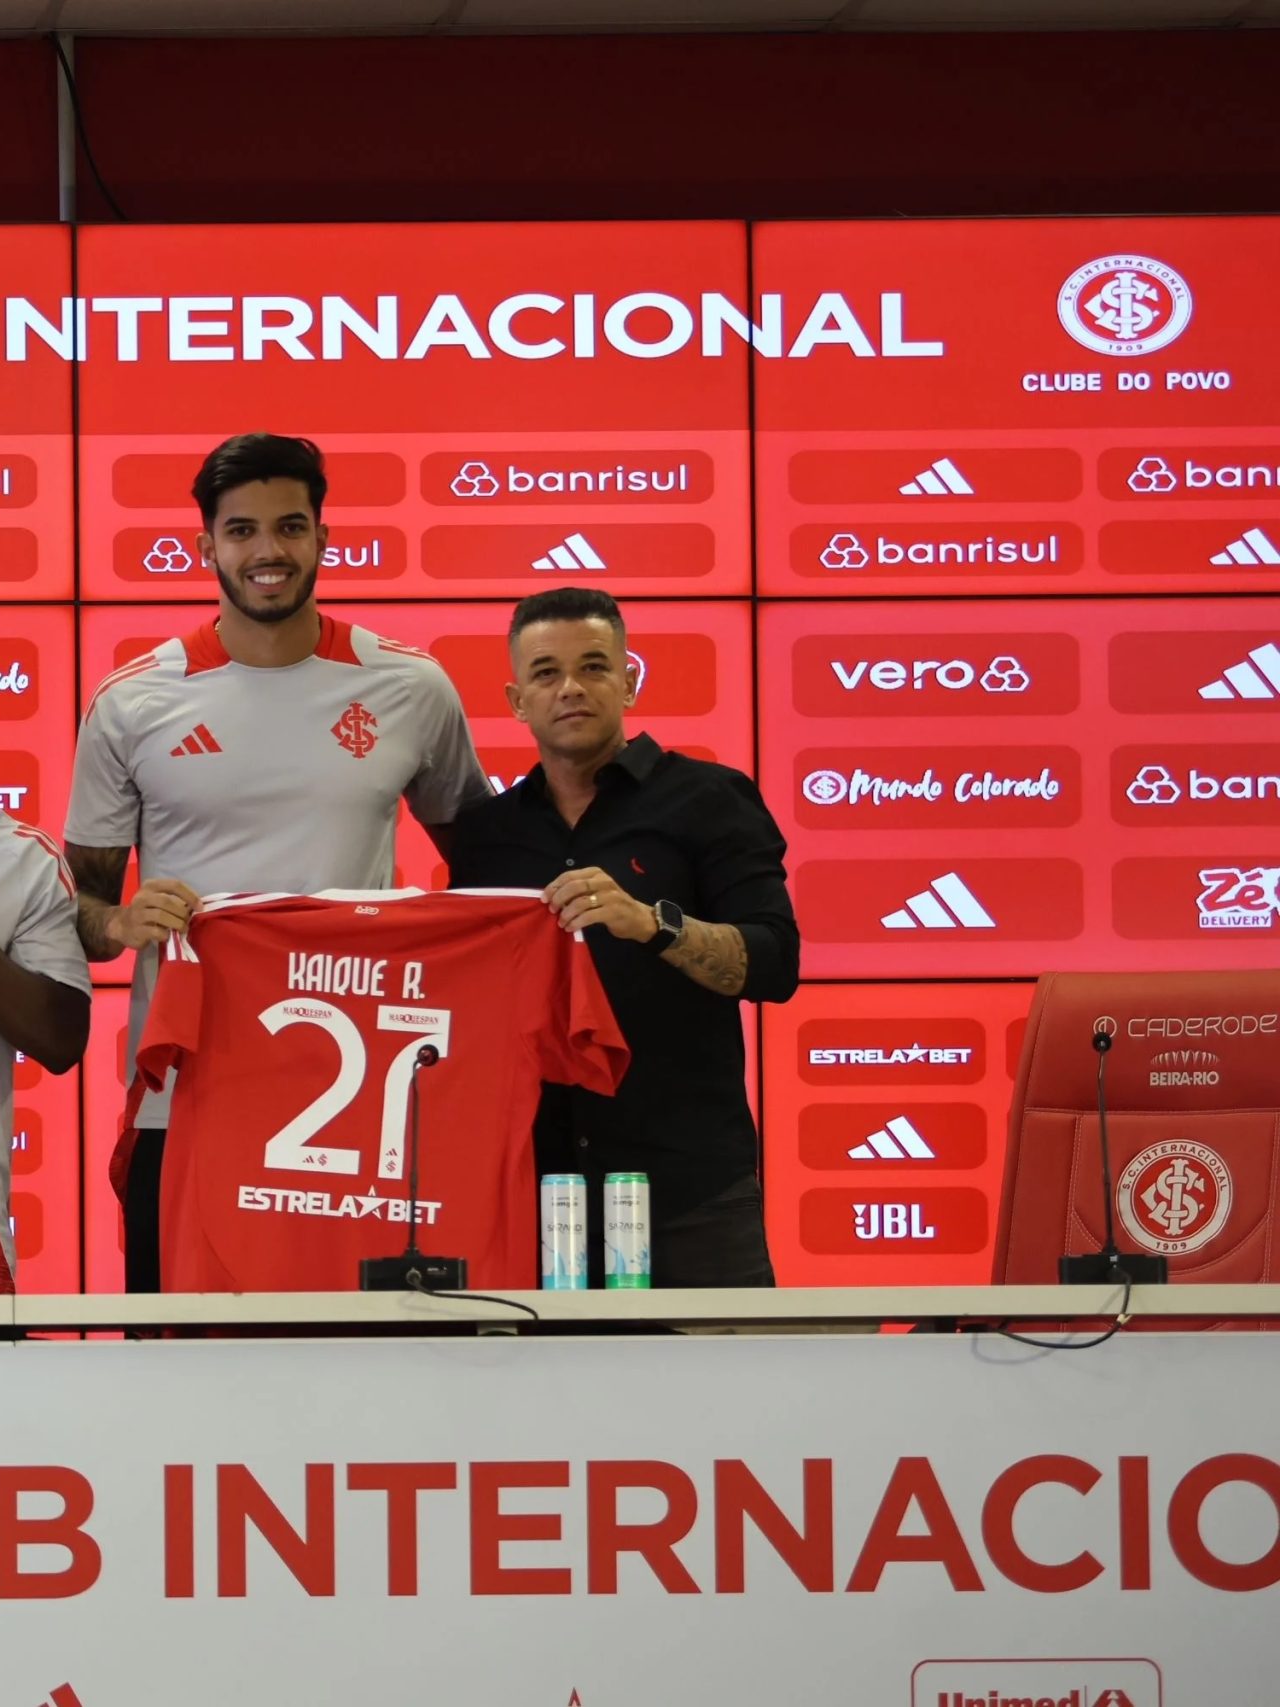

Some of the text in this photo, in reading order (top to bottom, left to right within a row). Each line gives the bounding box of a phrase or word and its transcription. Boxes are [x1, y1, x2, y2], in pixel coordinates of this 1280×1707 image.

[1022, 372, 1230, 391] CLUBE DO POVO
[508, 464, 686, 493] banrisul
[877, 535, 1056, 564] banrisul
[831, 660, 974, 690] vero
[847, 768, 1059, 806] Mundo Colorado
[1199, 870, 1271, 912] Zé
[1200, 916, 1270, 926] DELIVERY
[284, 952, 426, 1000] KAIQUE R.
[1127, 1014, 1278, 1038] CADERODE
[257, 997, 451, 1180] 27
[853, 1204, 935, 1239] JBL
[1155, 1242, 1187, 1251] 1909
[165, 1453, 1280, 1599] INTERNACIO
